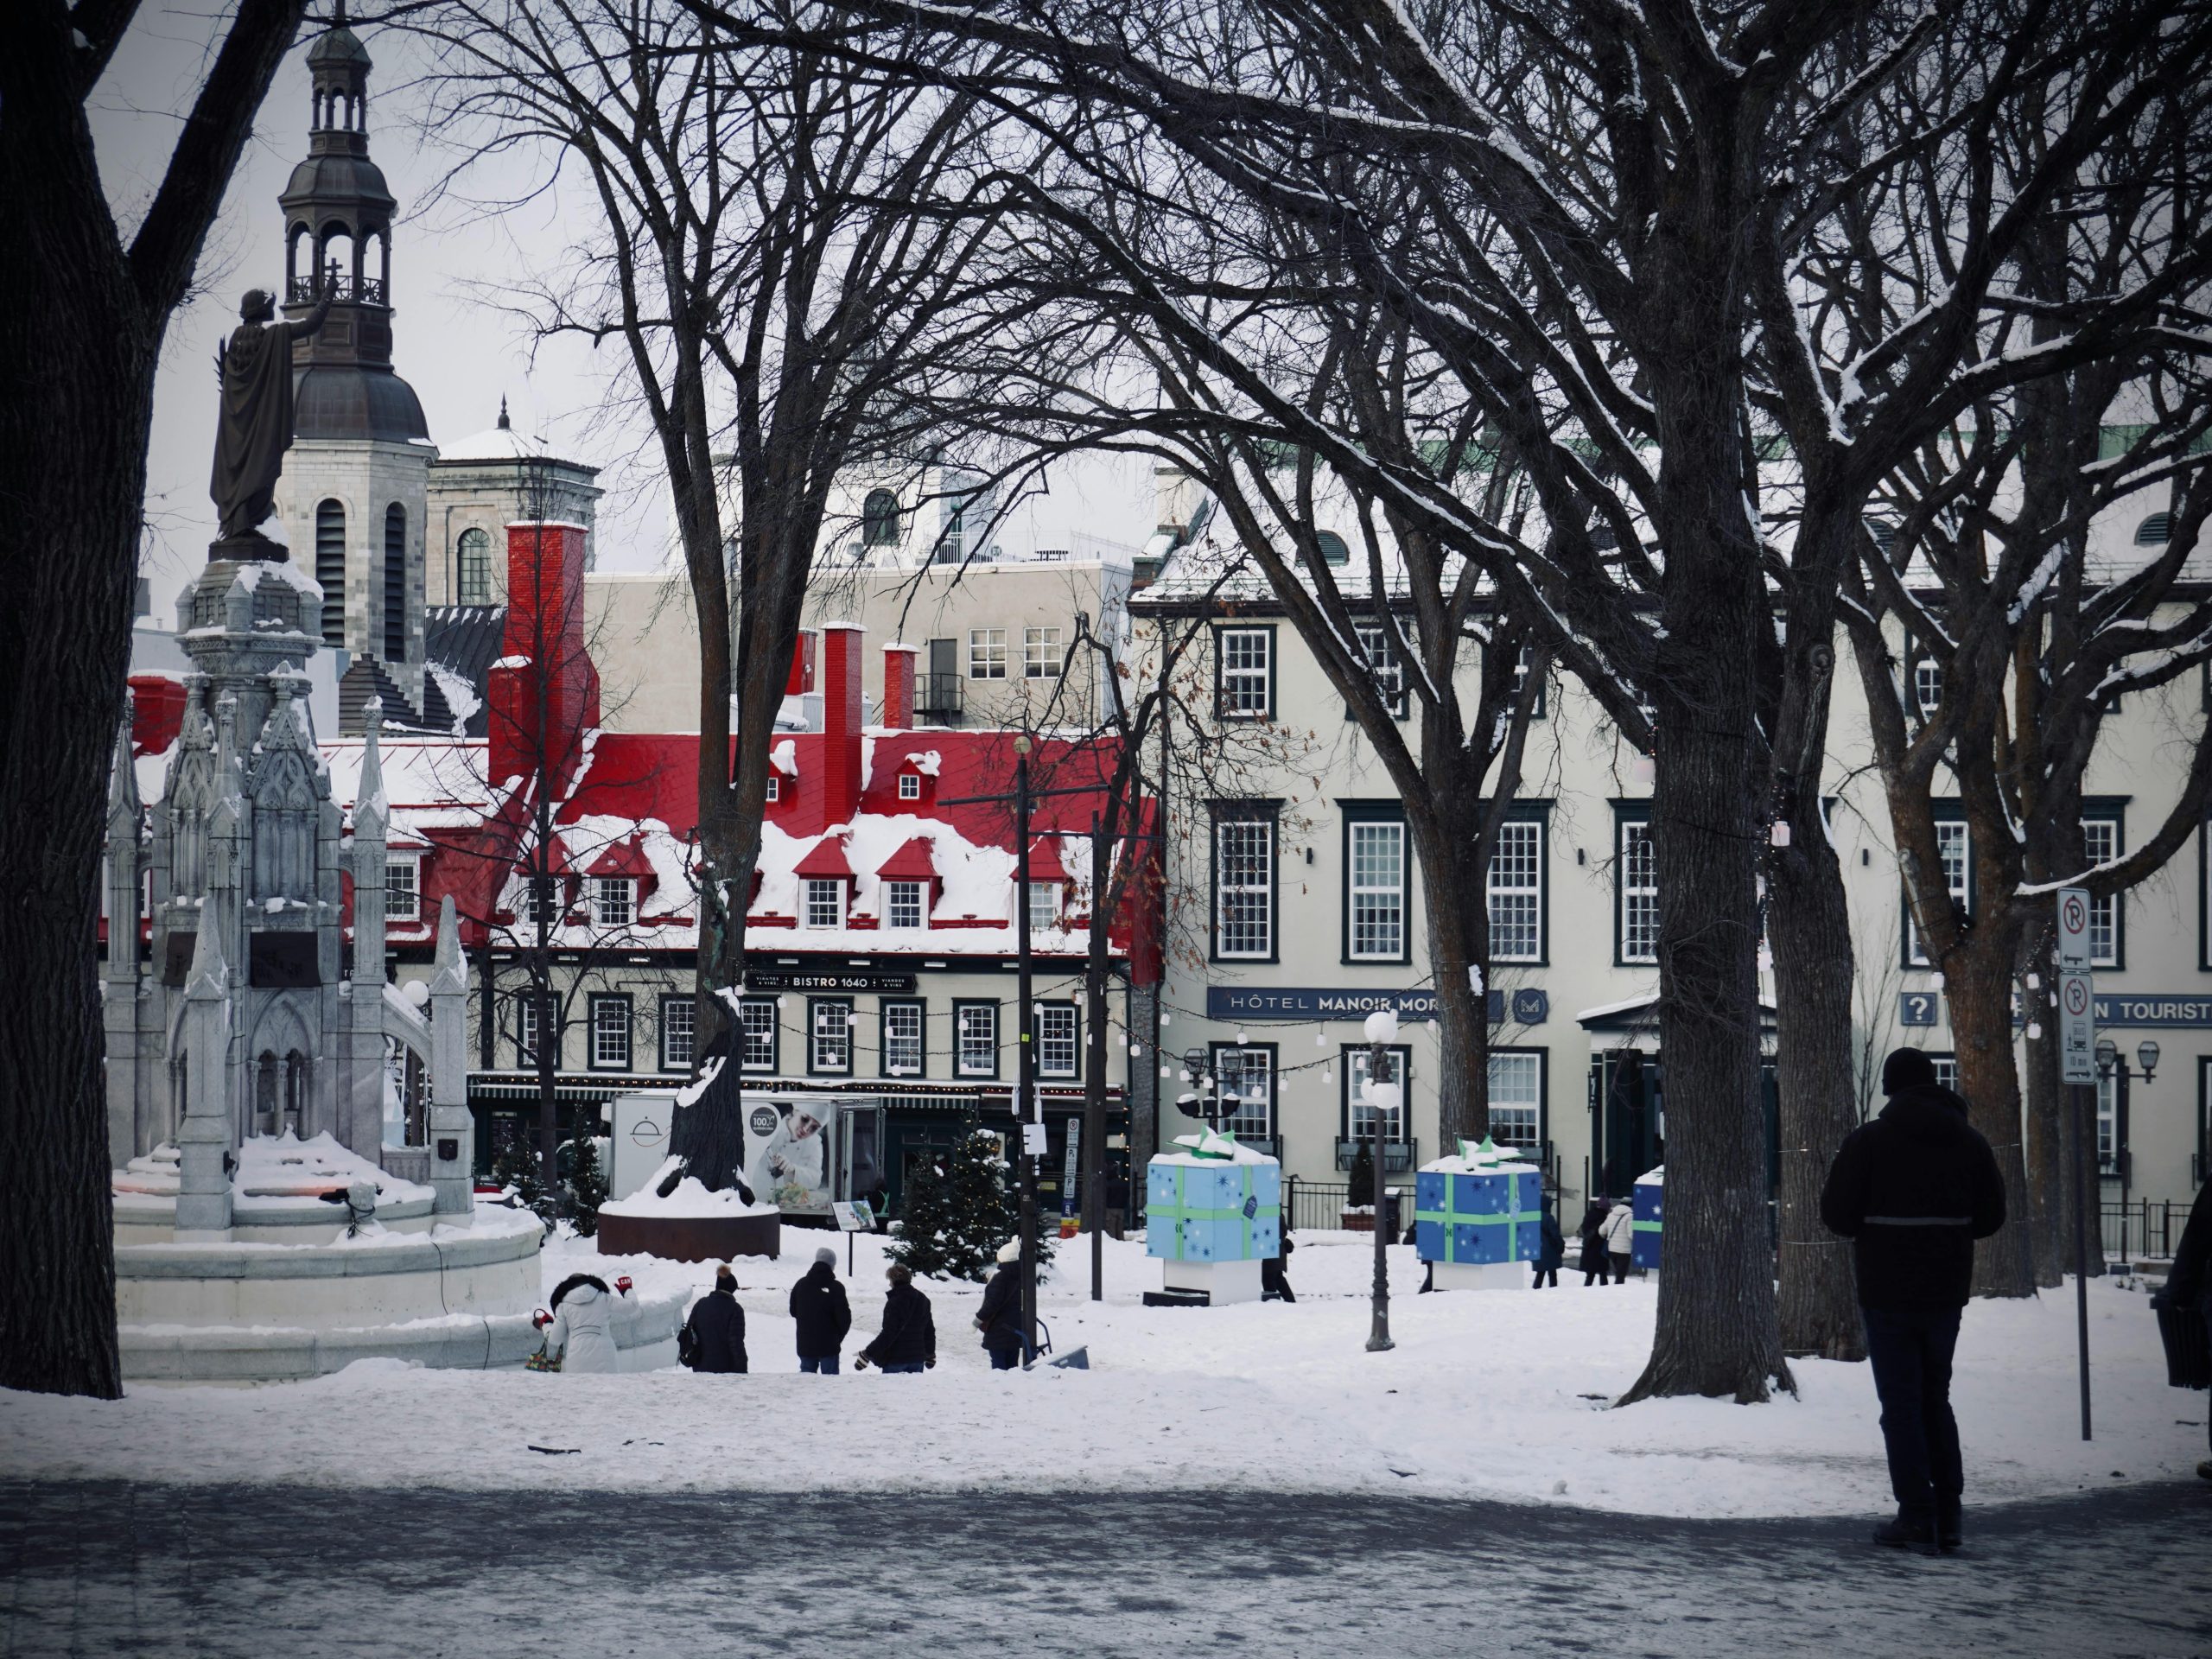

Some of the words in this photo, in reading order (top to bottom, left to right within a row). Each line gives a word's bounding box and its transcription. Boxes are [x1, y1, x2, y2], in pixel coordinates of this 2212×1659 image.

[793, 977, 836, 987] BISTRO
[841, 977, 868, 988] 1640
[1231, 994, 1309, 1009] HÔTEL
[1319, 997, 1391, 1011] MANOIR
[1400, 997, 1440, 1012] MOR
[2120, 1002, 2212, 1020] TOURIST
